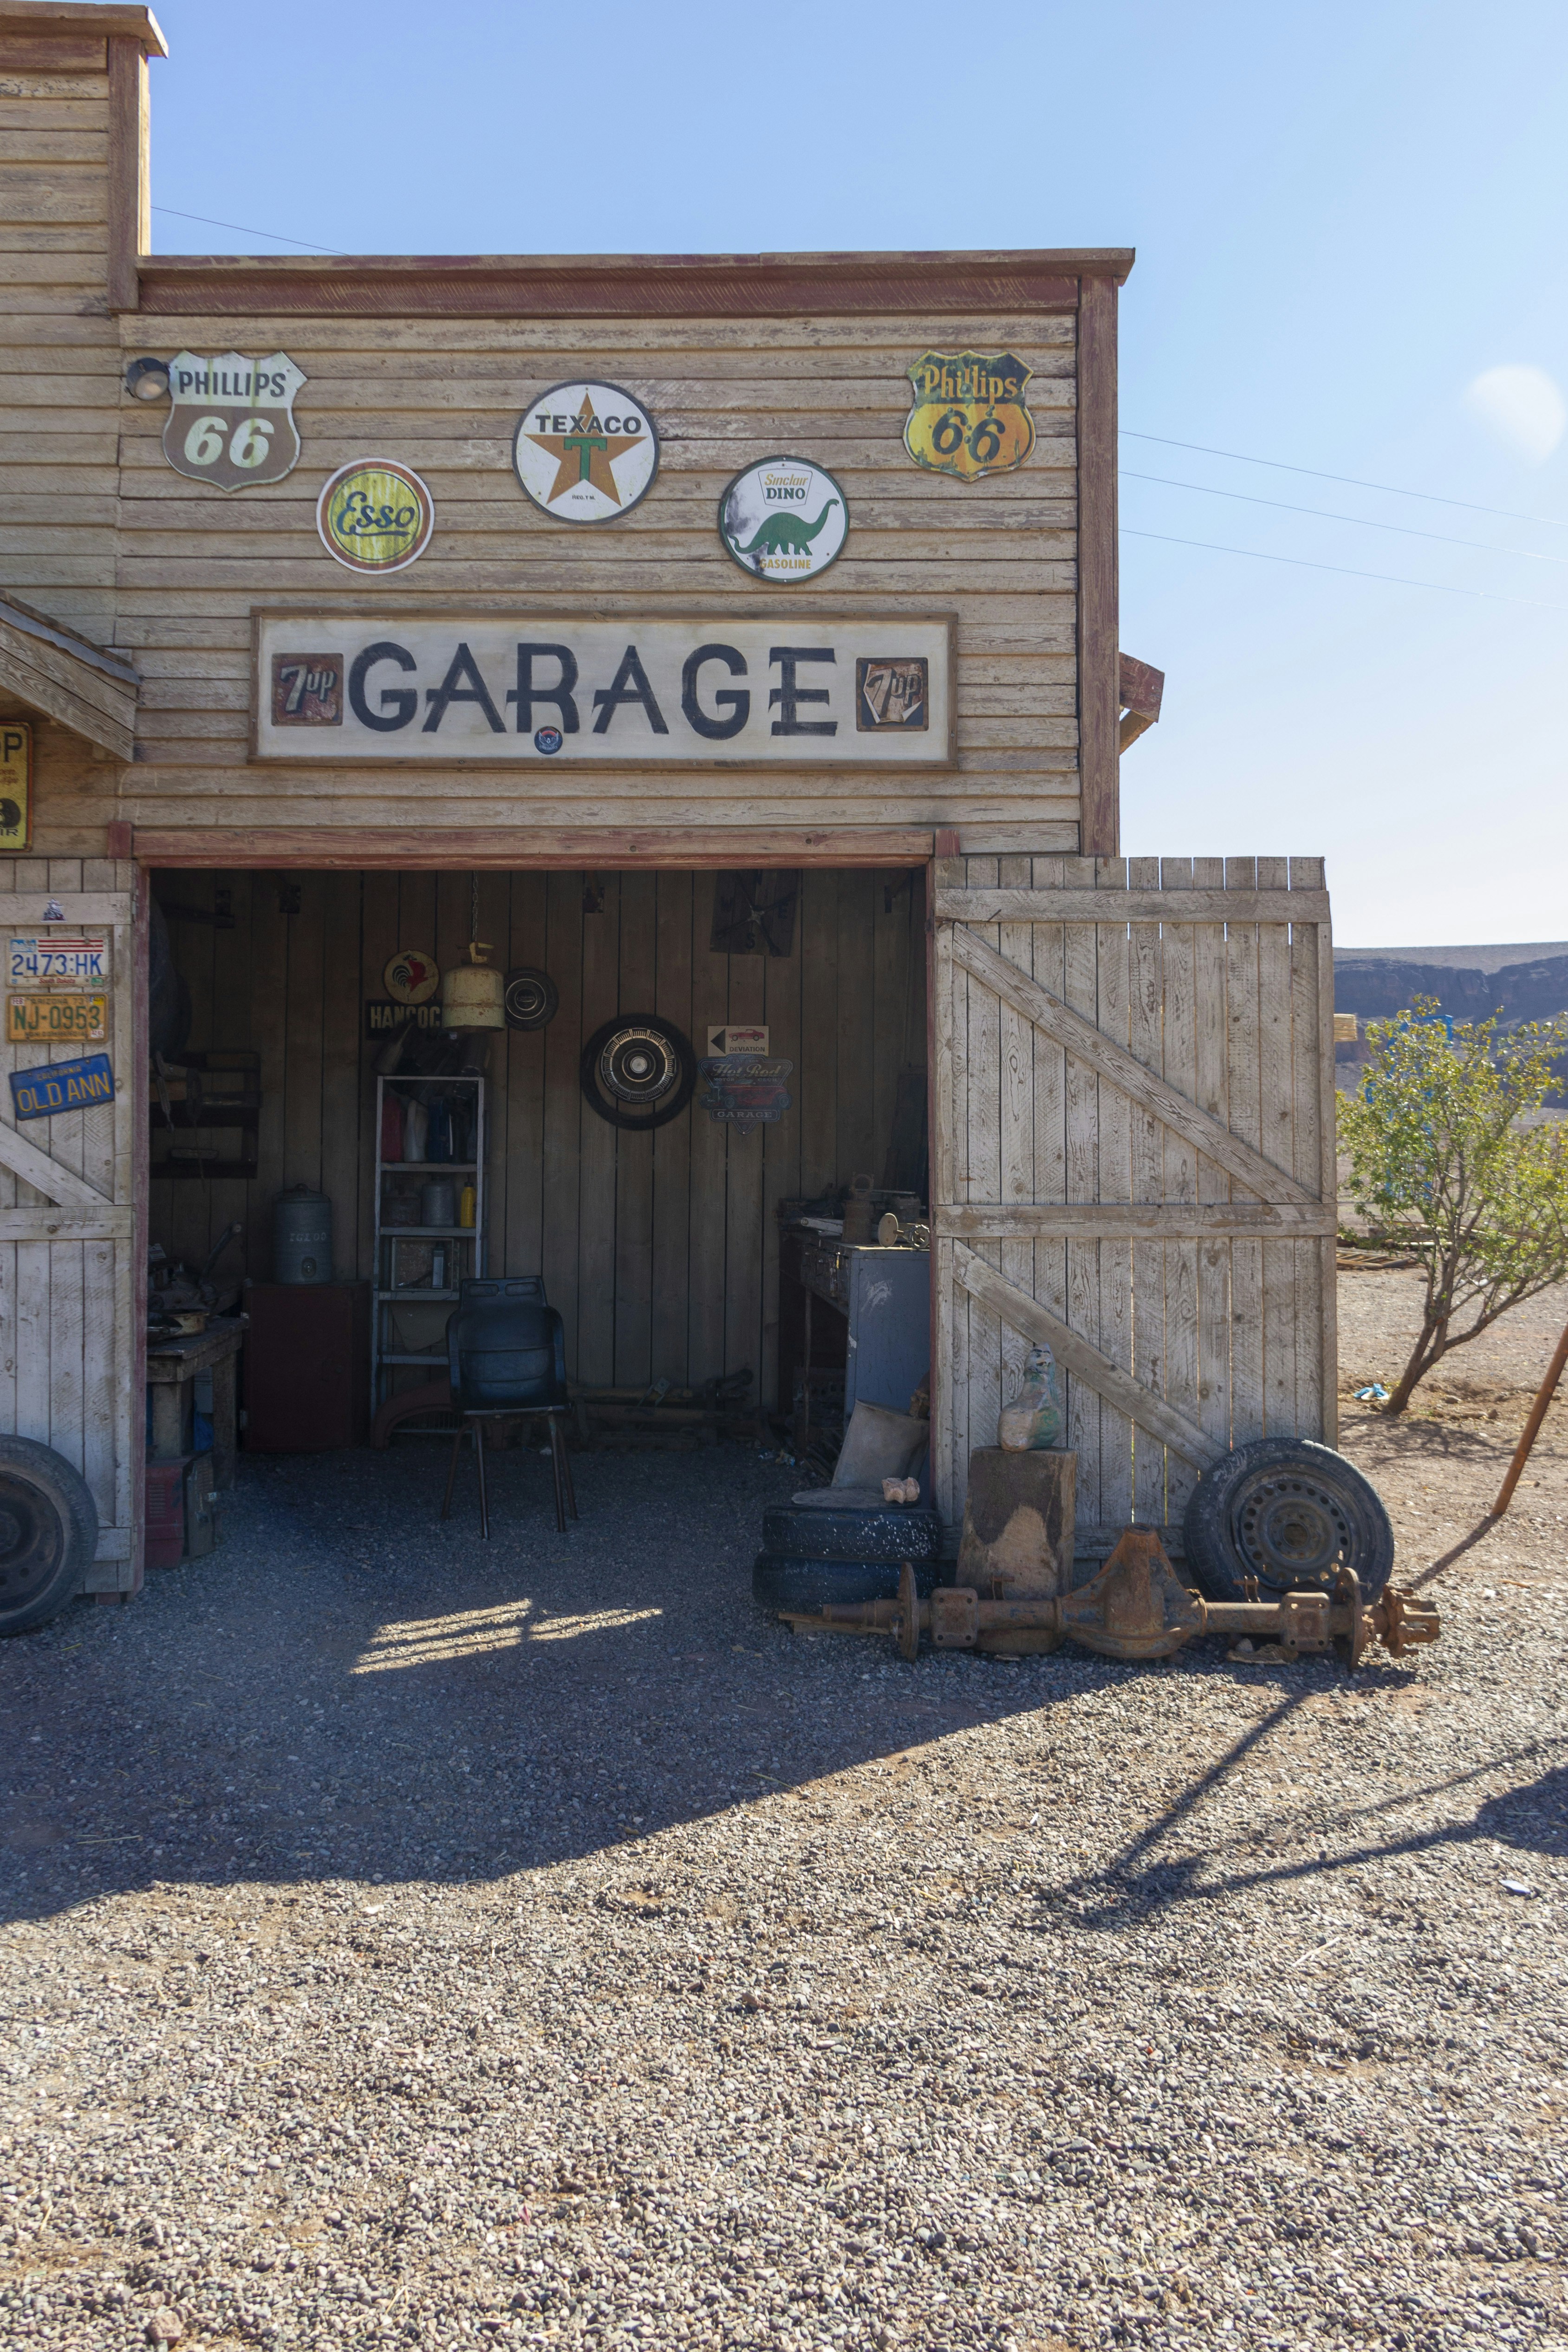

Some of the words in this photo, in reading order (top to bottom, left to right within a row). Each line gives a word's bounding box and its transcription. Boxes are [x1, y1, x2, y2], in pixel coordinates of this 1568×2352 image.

[178, 371, 286, 398] PHILLIPS
[918, 364, 1018, 405] Phillips
[535, 415, 642, 434] TEXACO
[932, 409, 1006, 463] 66
[184, 416, 274, 468] 66
[764, 474, 808, 486] Sinclair
[766, 487, 806, 500] DINO
[336, 490, 415, 537] Esso
[759, 558, 811, 569] GASOLINE
[348, 641, 839, 741] GARAGE
[14, 1006, 100, 1030] NJ-0953
[712, 1063, 743, 1077] Hot
[743, 1063, 781, 1078] Rod
[17, 1082, 63, 1112] OLD
[67, 1072, 111, 1102] ANN
